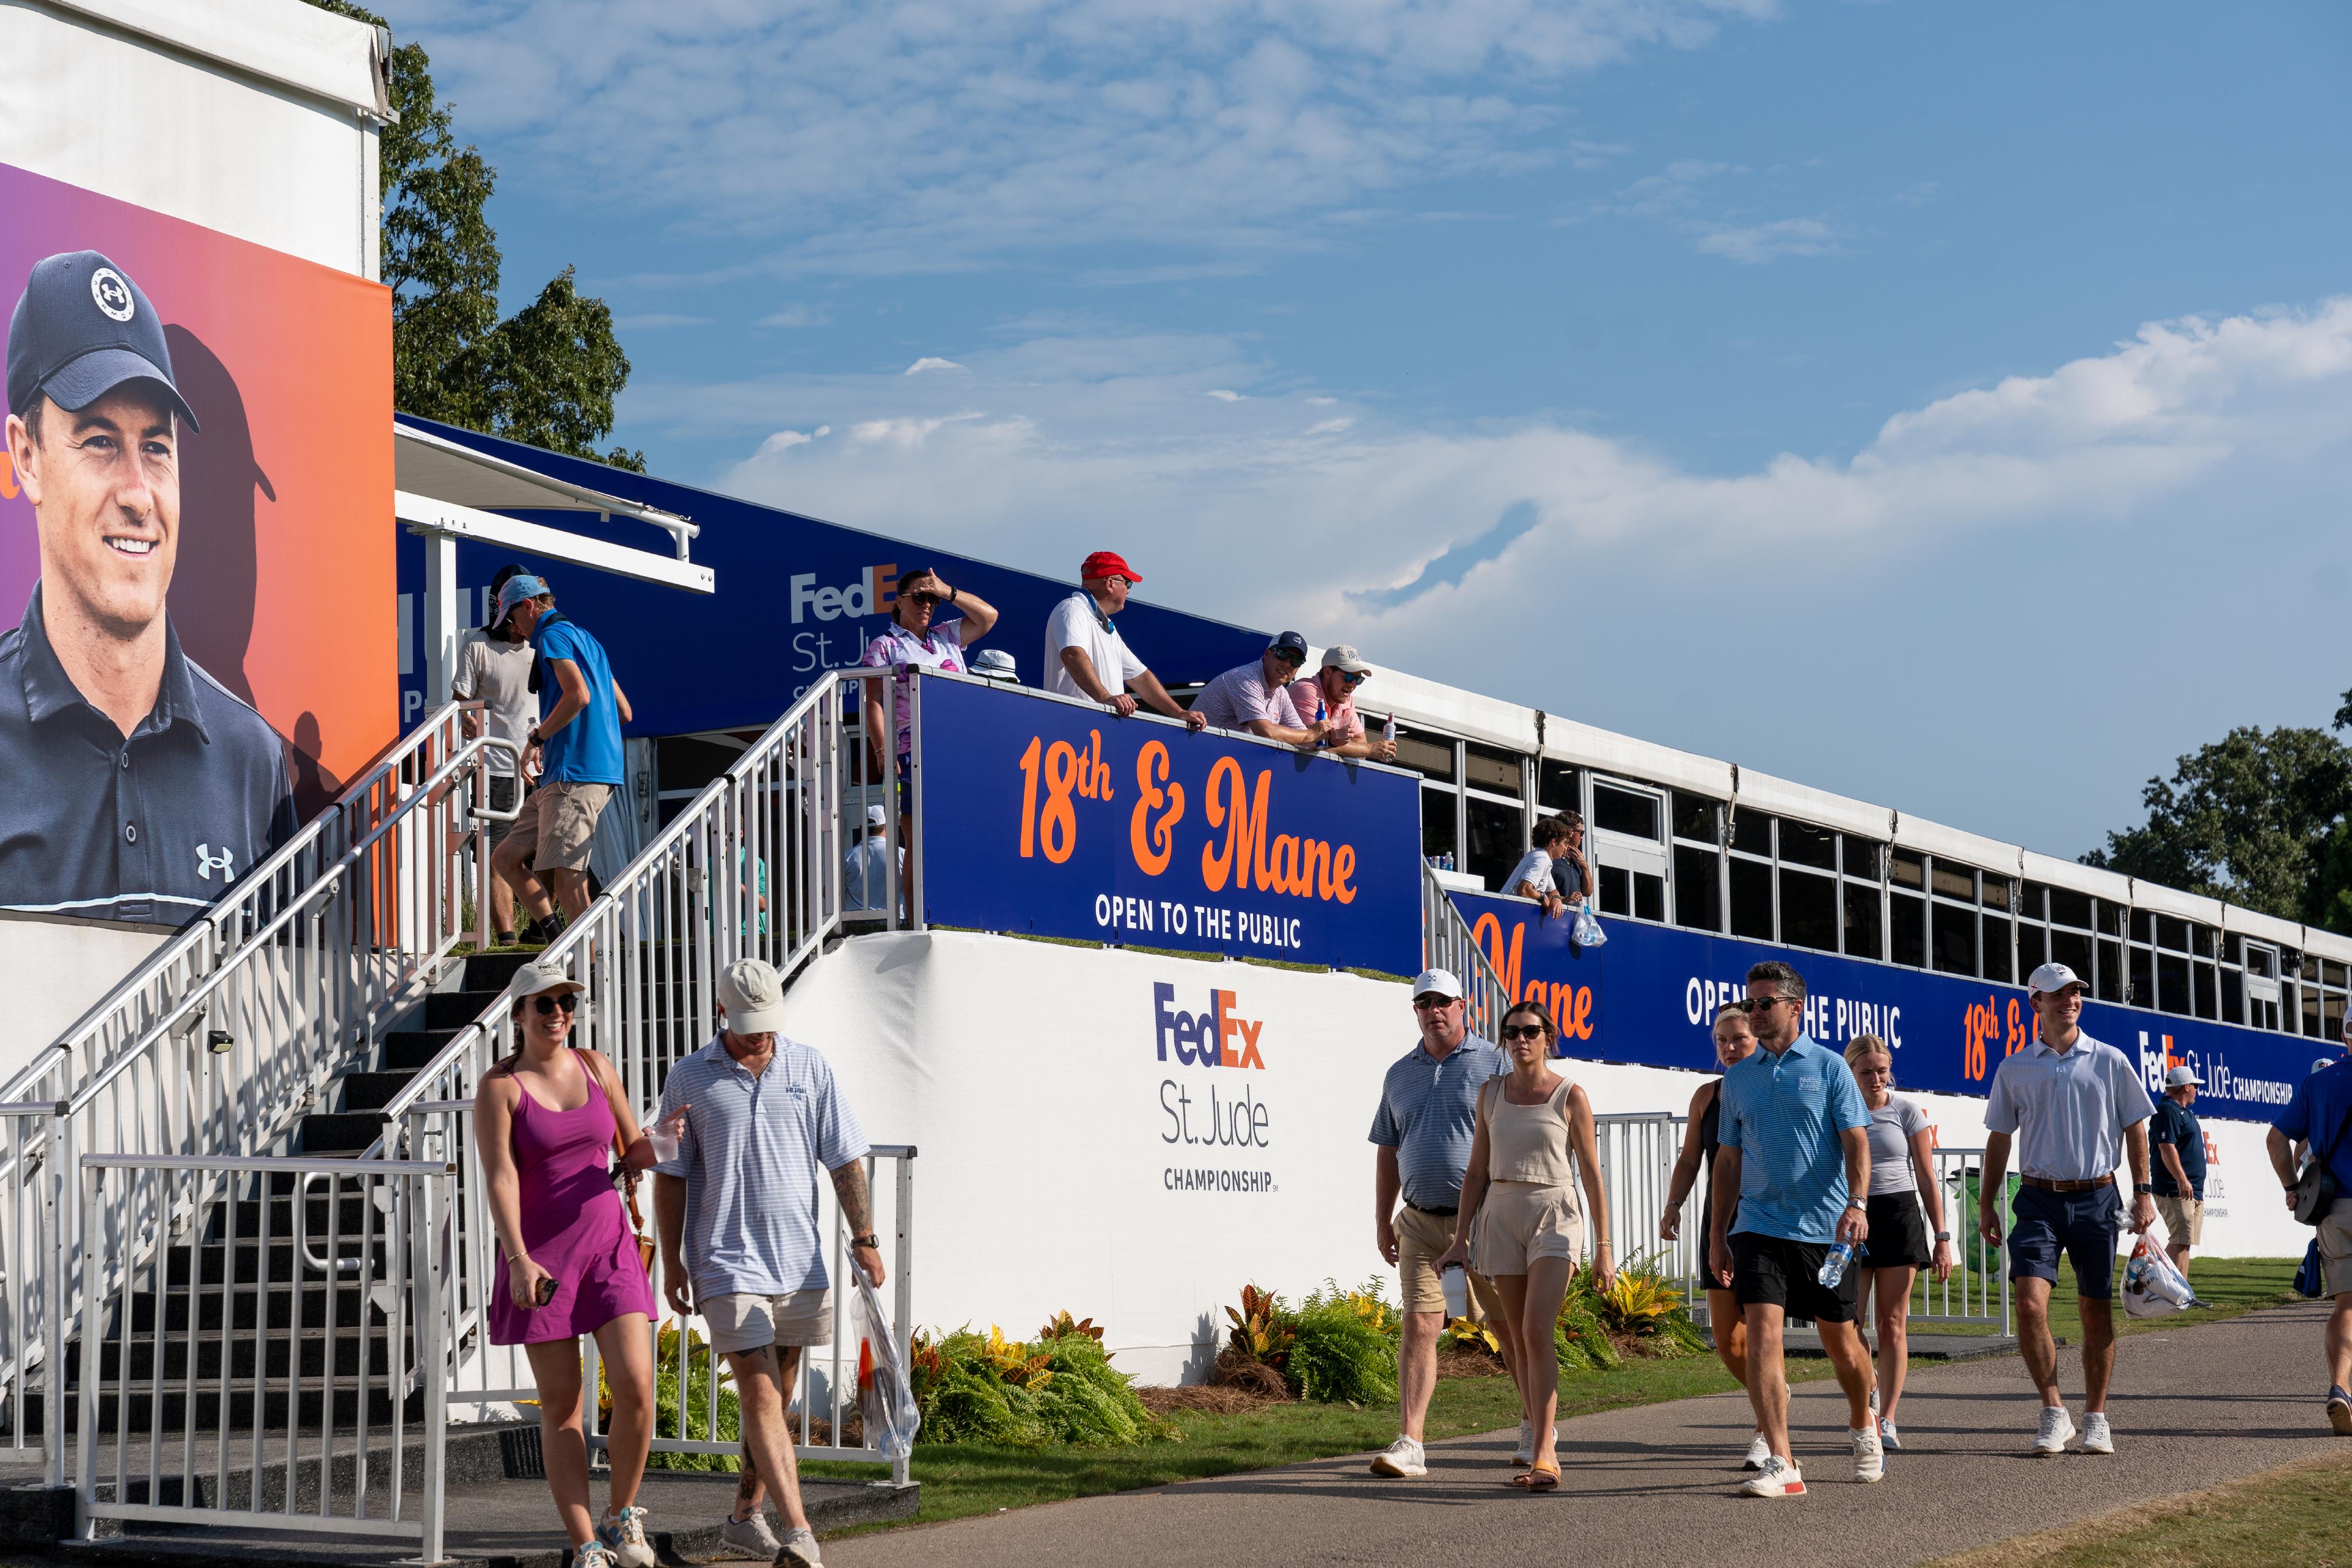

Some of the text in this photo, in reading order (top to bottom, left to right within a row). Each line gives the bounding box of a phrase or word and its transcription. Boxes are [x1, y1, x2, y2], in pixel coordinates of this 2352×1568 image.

[791, 563, 897, 624] FedE
[793, 633, 839, 672] St.
[1020, 729, 1357, 904] 18th & Mane
[1095, 894, 1301, 948] OPEN TO THE PUBLIC
[1153, 981, 1266, 1070] FedEx
[1803, 994, 1829, 1040] HE
[1836, 998, 1902, 1048] PUBLIC
[1964, 996, 1999, 1081] 18th
[2139, 1031, 2185, 1094] FedE
[2204, 1052, 2231, 1099] Jude
[2233, 1076, 2293, 1105] CHAMPIONSHIP
[1160, 1079, 1268, 1148] St. Jude
[1164, 1168, 1271, 1192] CHAMPIONSHIP
